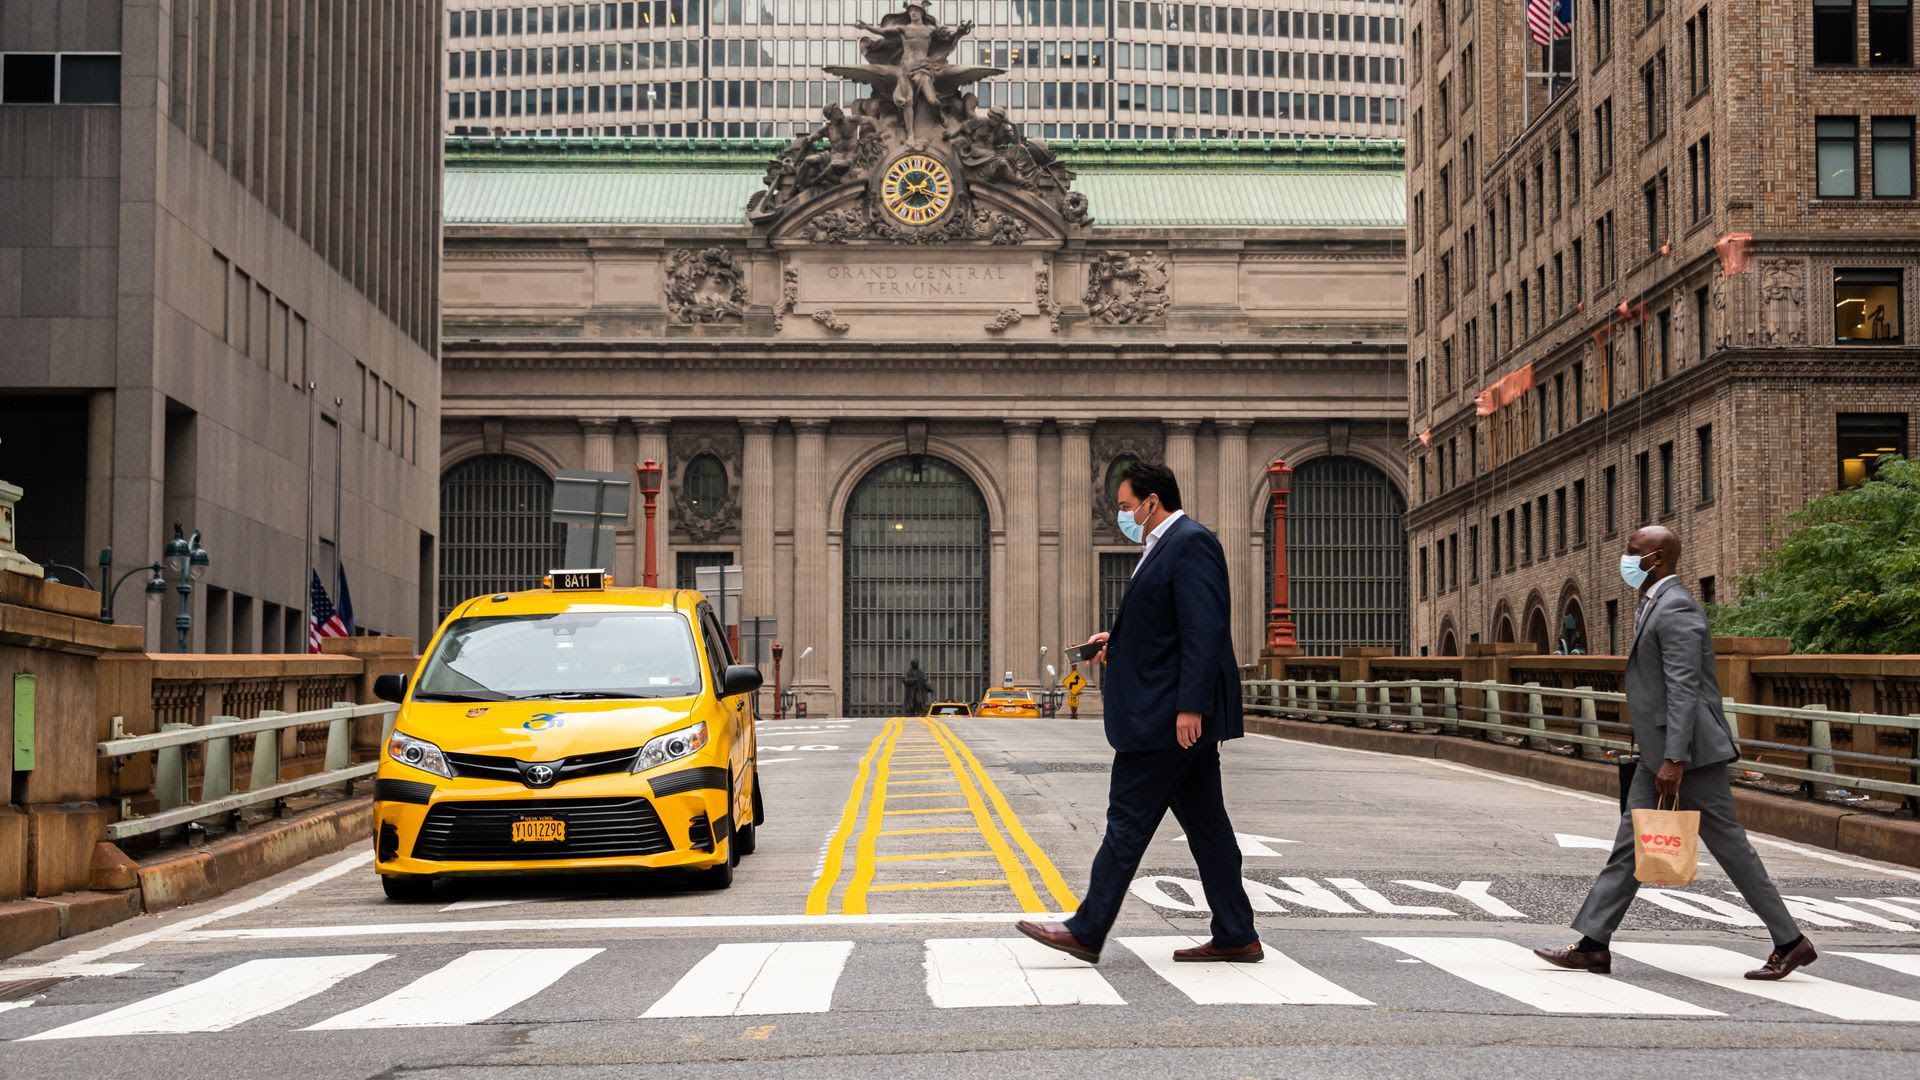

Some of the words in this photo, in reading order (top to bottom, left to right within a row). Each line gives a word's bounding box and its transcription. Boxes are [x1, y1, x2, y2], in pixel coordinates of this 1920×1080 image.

[827, 266, 897, 280] GRAND
[912, 266, 1006, 280] CENTRAL
[866, 282, 967, 295] TERMINAL
[565, 574, 590, 587] 8A11
[515, 823, 562, 837] Y101229C
[1653, 834, 1682, 847] CVS
[1130, 876, 1529, 917] ONLY
